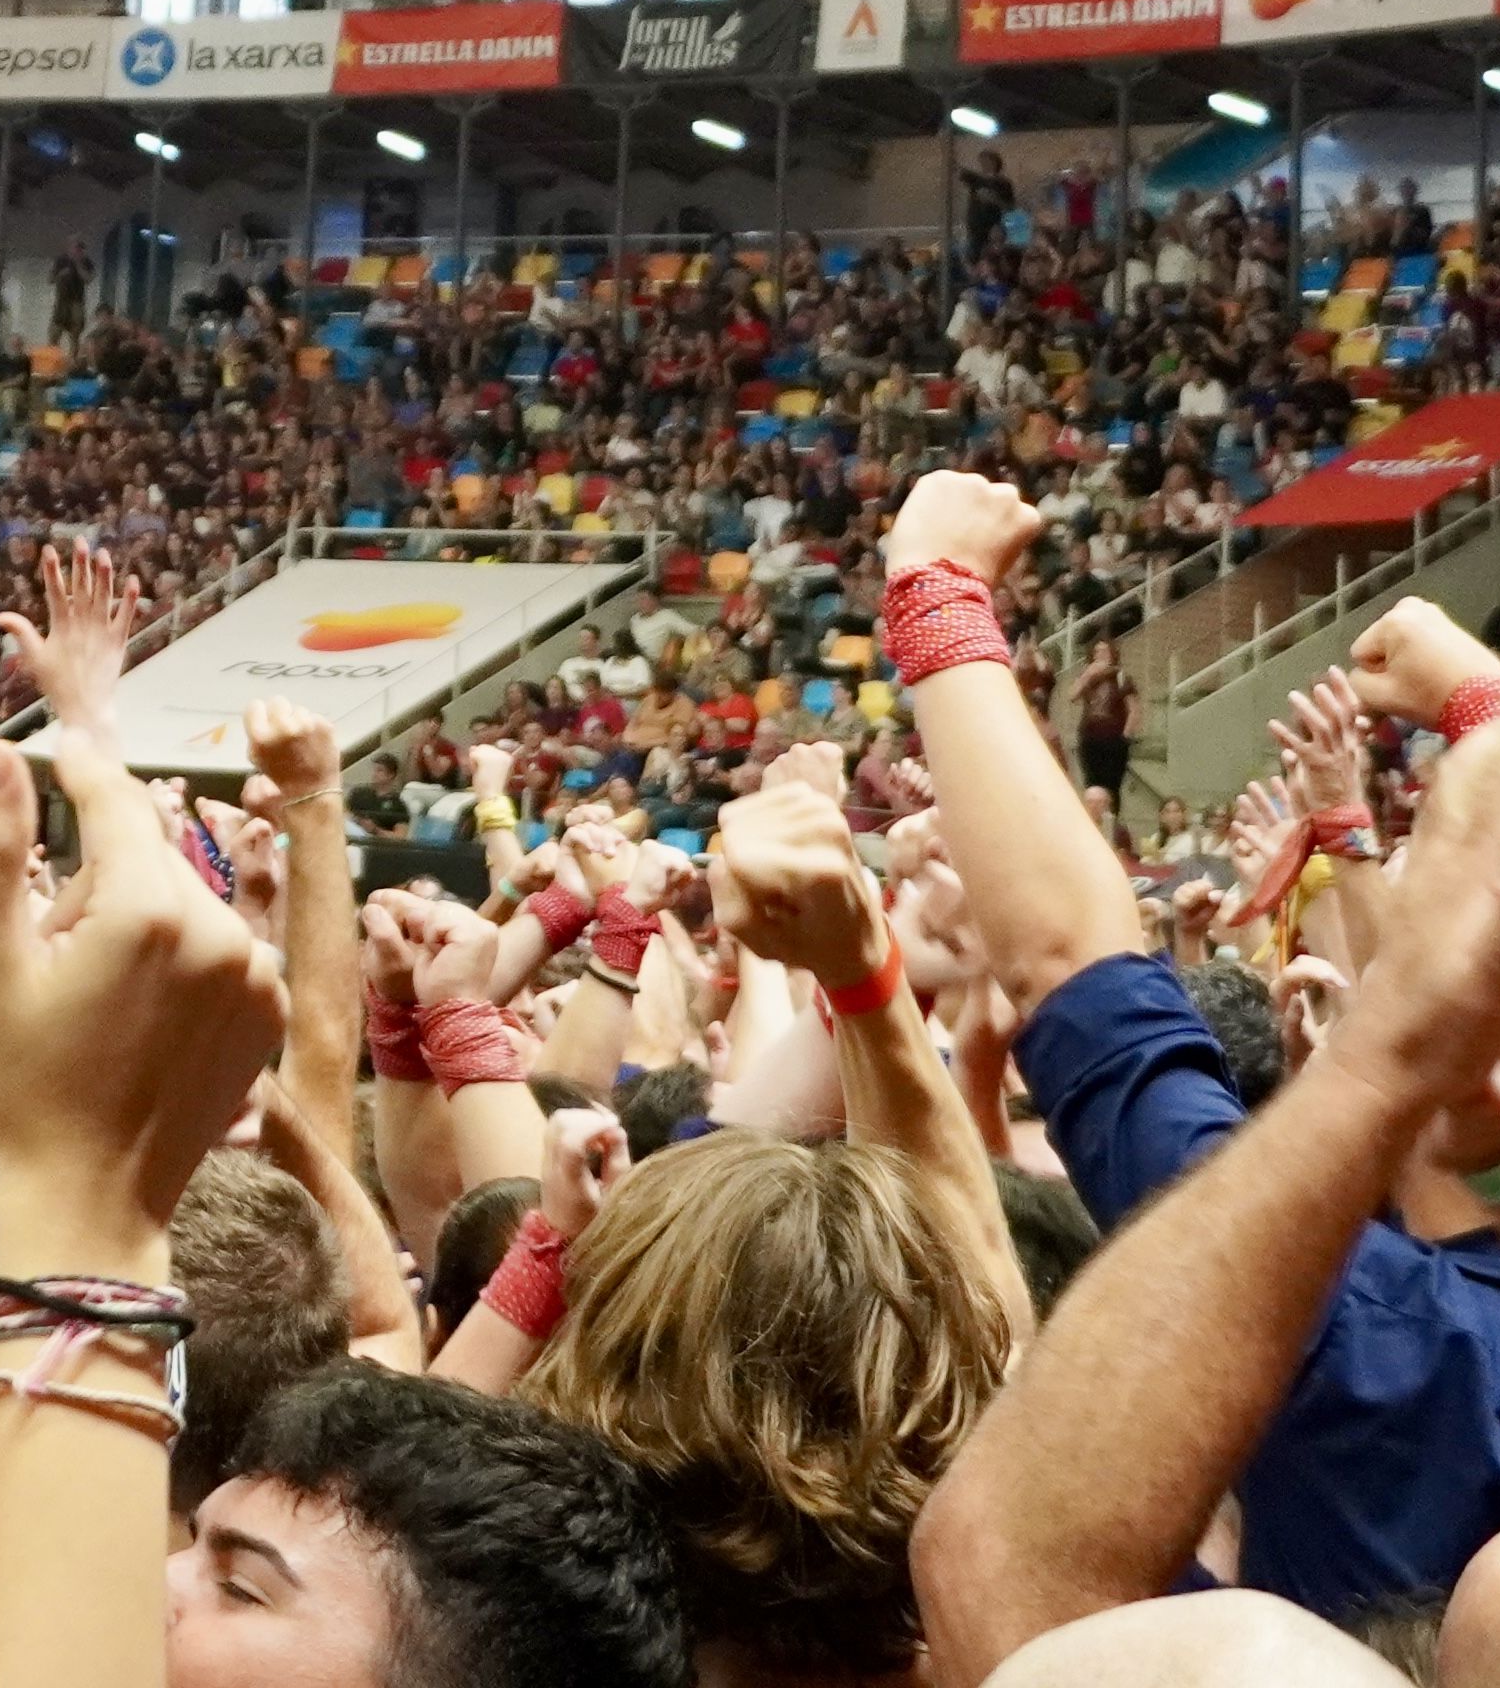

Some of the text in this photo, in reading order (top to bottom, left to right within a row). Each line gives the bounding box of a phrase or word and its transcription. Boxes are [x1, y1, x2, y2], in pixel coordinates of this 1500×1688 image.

[187, 38, 326, 71] la xarxa
[361, 34, 556, 67] ESTRELLA DAMM
[220, 658, 412, 681] repsol
